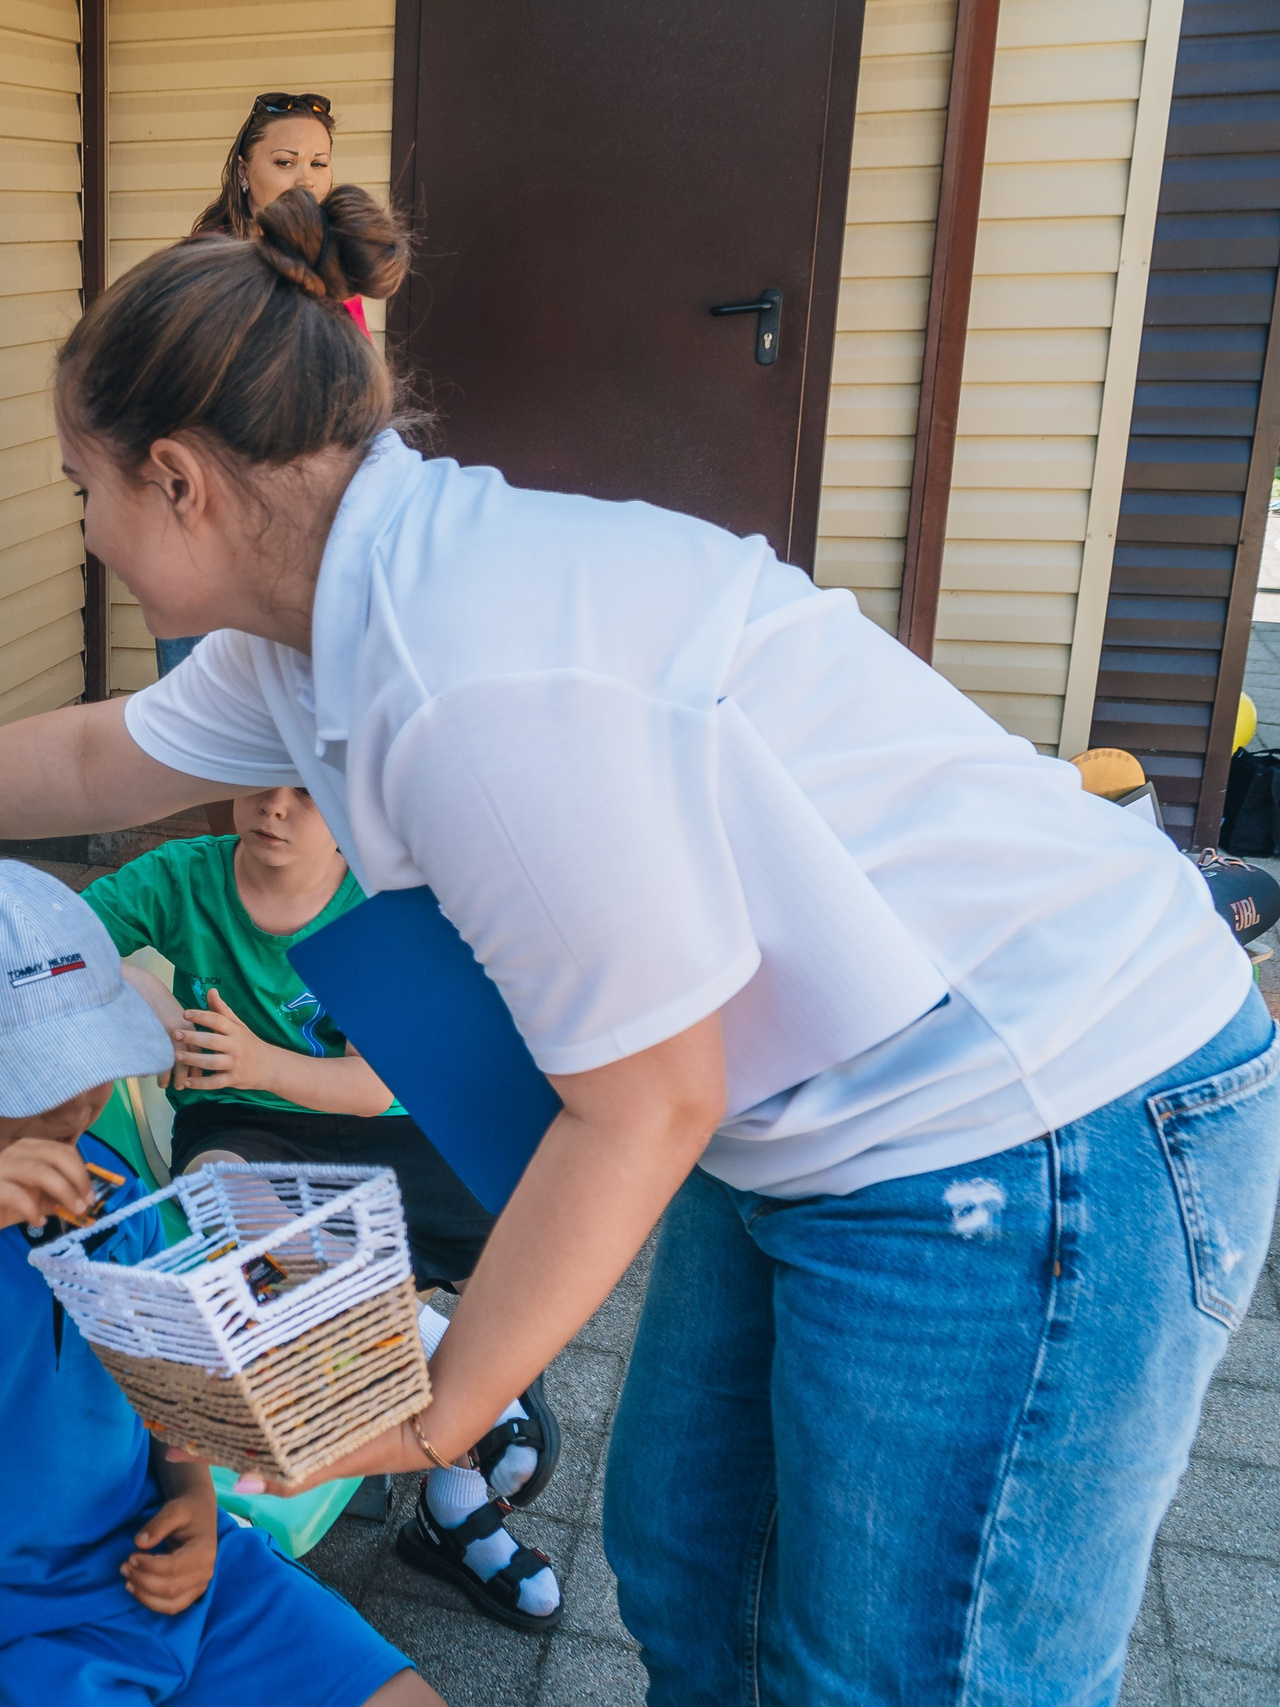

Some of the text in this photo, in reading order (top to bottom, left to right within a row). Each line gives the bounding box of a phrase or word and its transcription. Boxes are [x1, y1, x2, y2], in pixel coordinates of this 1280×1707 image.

[1229, 896, 1260, 932] JBL
[7, 953, 82, 979] TOMMY HILFIGER
